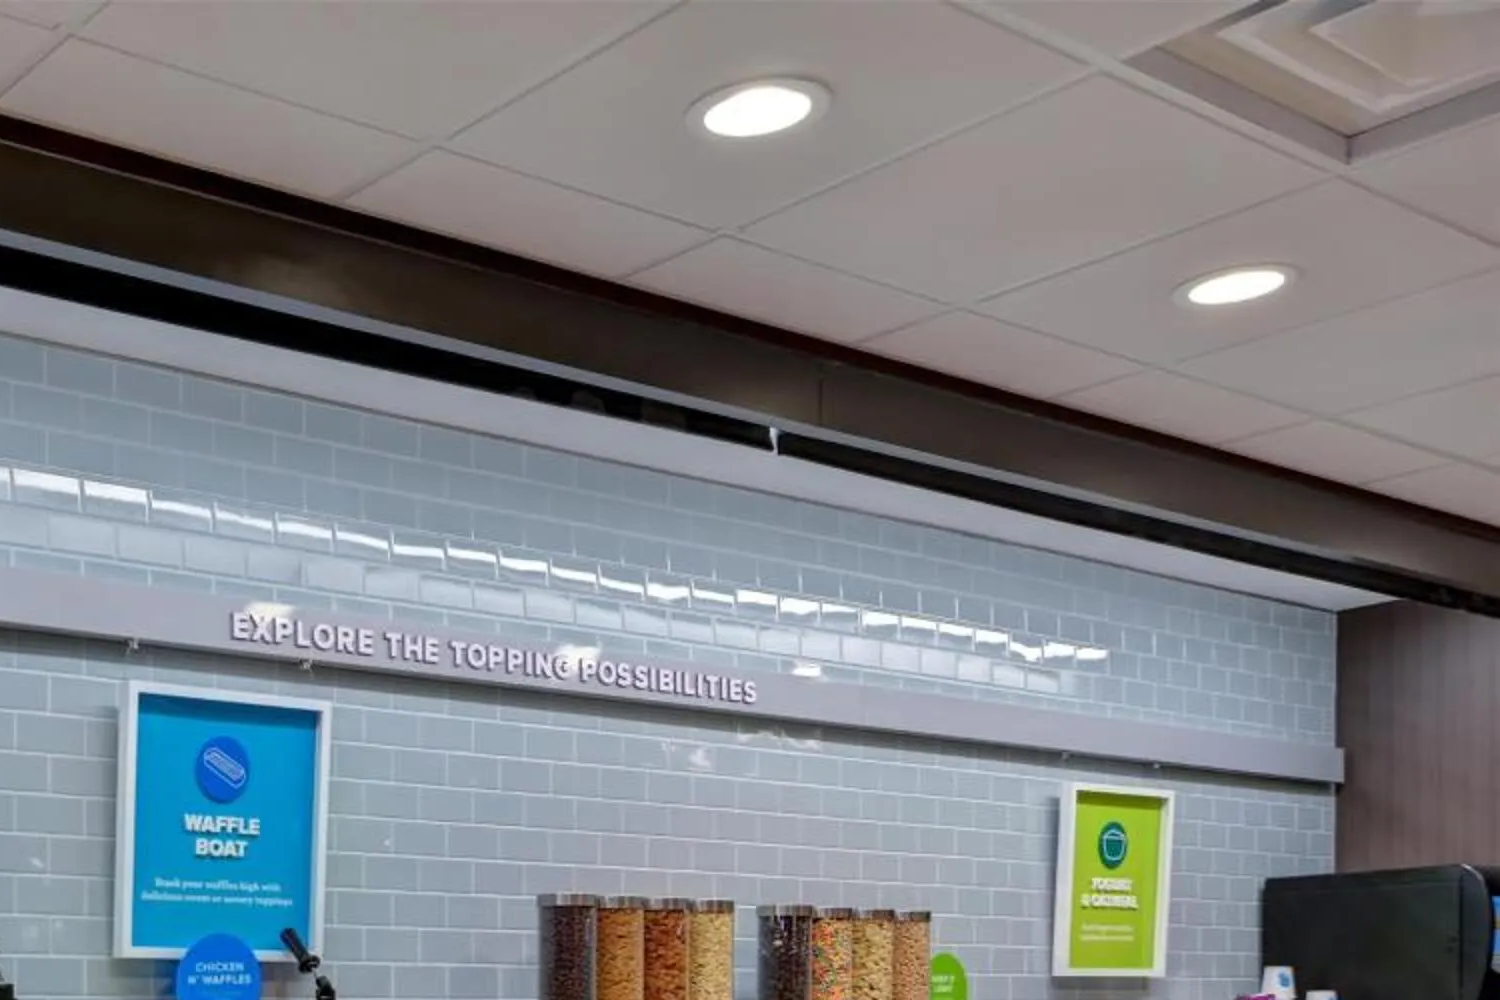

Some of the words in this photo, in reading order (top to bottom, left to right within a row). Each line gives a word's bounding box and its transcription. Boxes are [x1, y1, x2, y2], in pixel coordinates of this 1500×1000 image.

[231, 611, 374, 656] EXPLORE
[385, 631, 439, 665] THE
[448, 640, 574, 680] TOPPING
[579, 659, 758, 704] POSSIBILITIES
[184, 813, 261, 835] WAFFLE
[195, 838, 249, 858] BOAT
[195, 961, 245, 973] CHICKEN
[203, 974, 252, 986] WAFFLES
